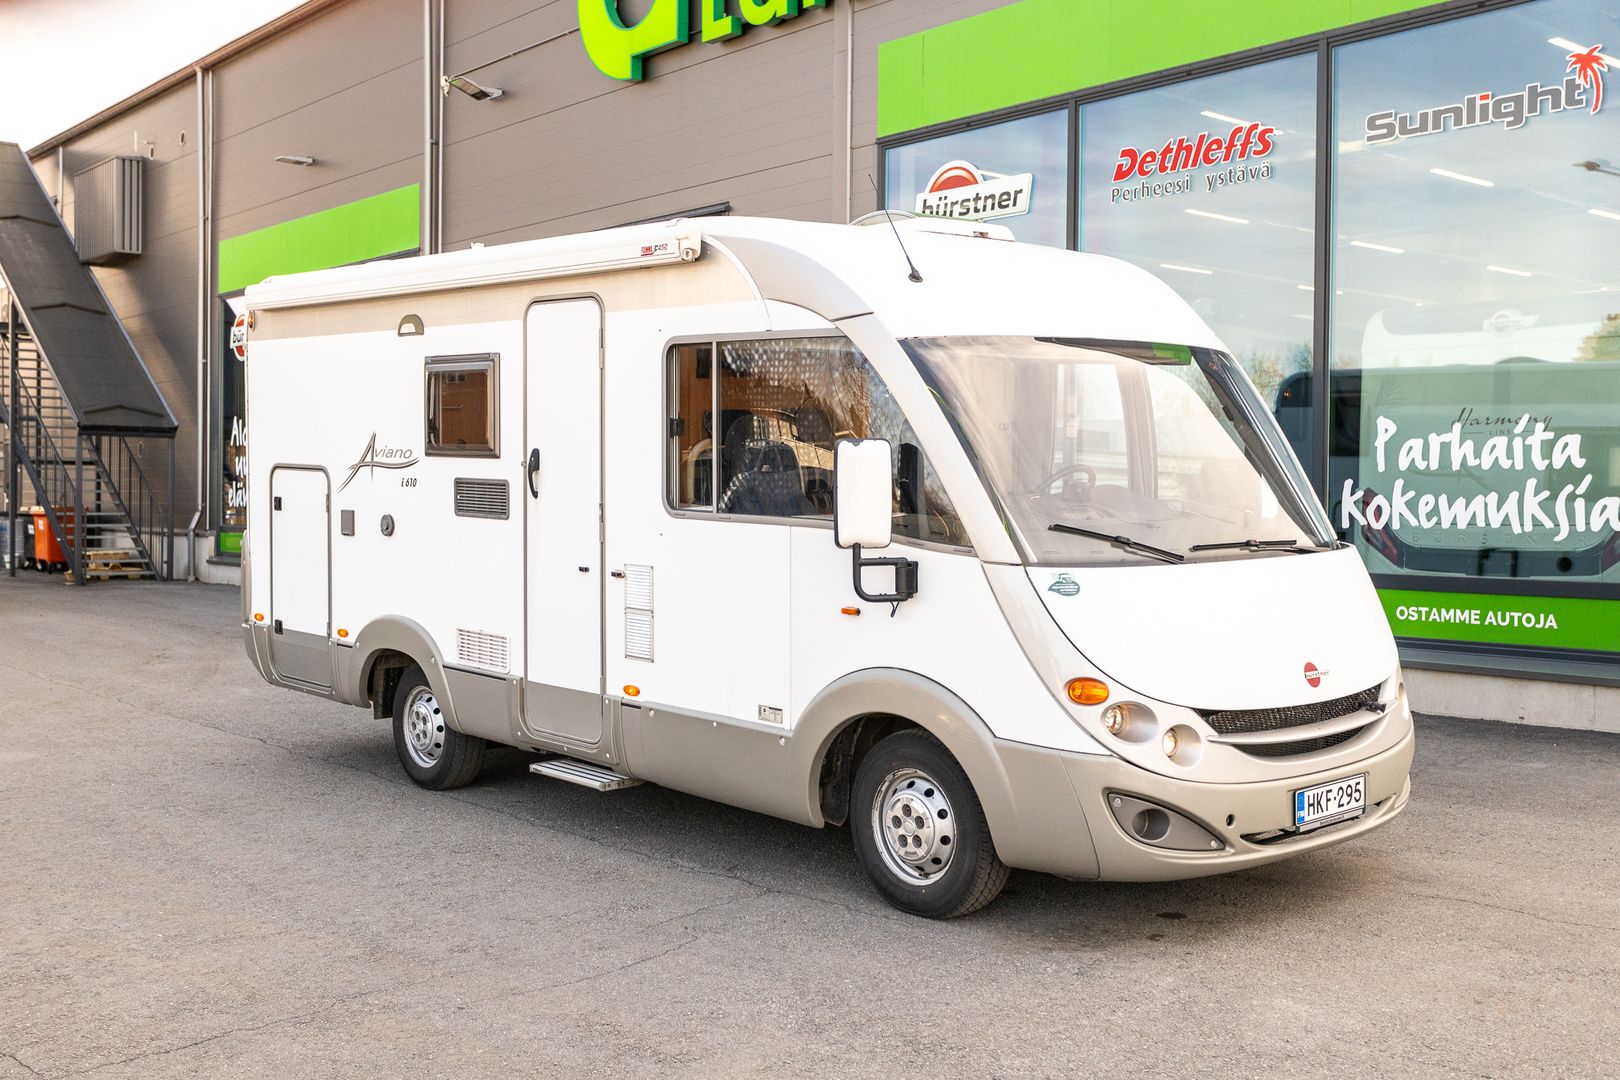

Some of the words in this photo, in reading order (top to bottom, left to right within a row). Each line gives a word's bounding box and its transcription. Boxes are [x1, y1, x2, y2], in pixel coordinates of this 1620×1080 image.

[1365, 76, 1586, 143] Sunlight
[1111, 174, 1190, 202] Perheesi
[1206, 162, 1271, 192] ystävä
[1112, 123, 1274, 182] Dethleffs
[337, 431, 416, 493] Aviano
[1373, 413, 1587, 473] Parhaita
[1341, 474, 1620, 541] kokemuksia
[1395, 605, 1481, 625] OSTAMME
[1484, 611, 1559, 630] AUTOJA
[1307, 781, 1362, 817] HKF-295
